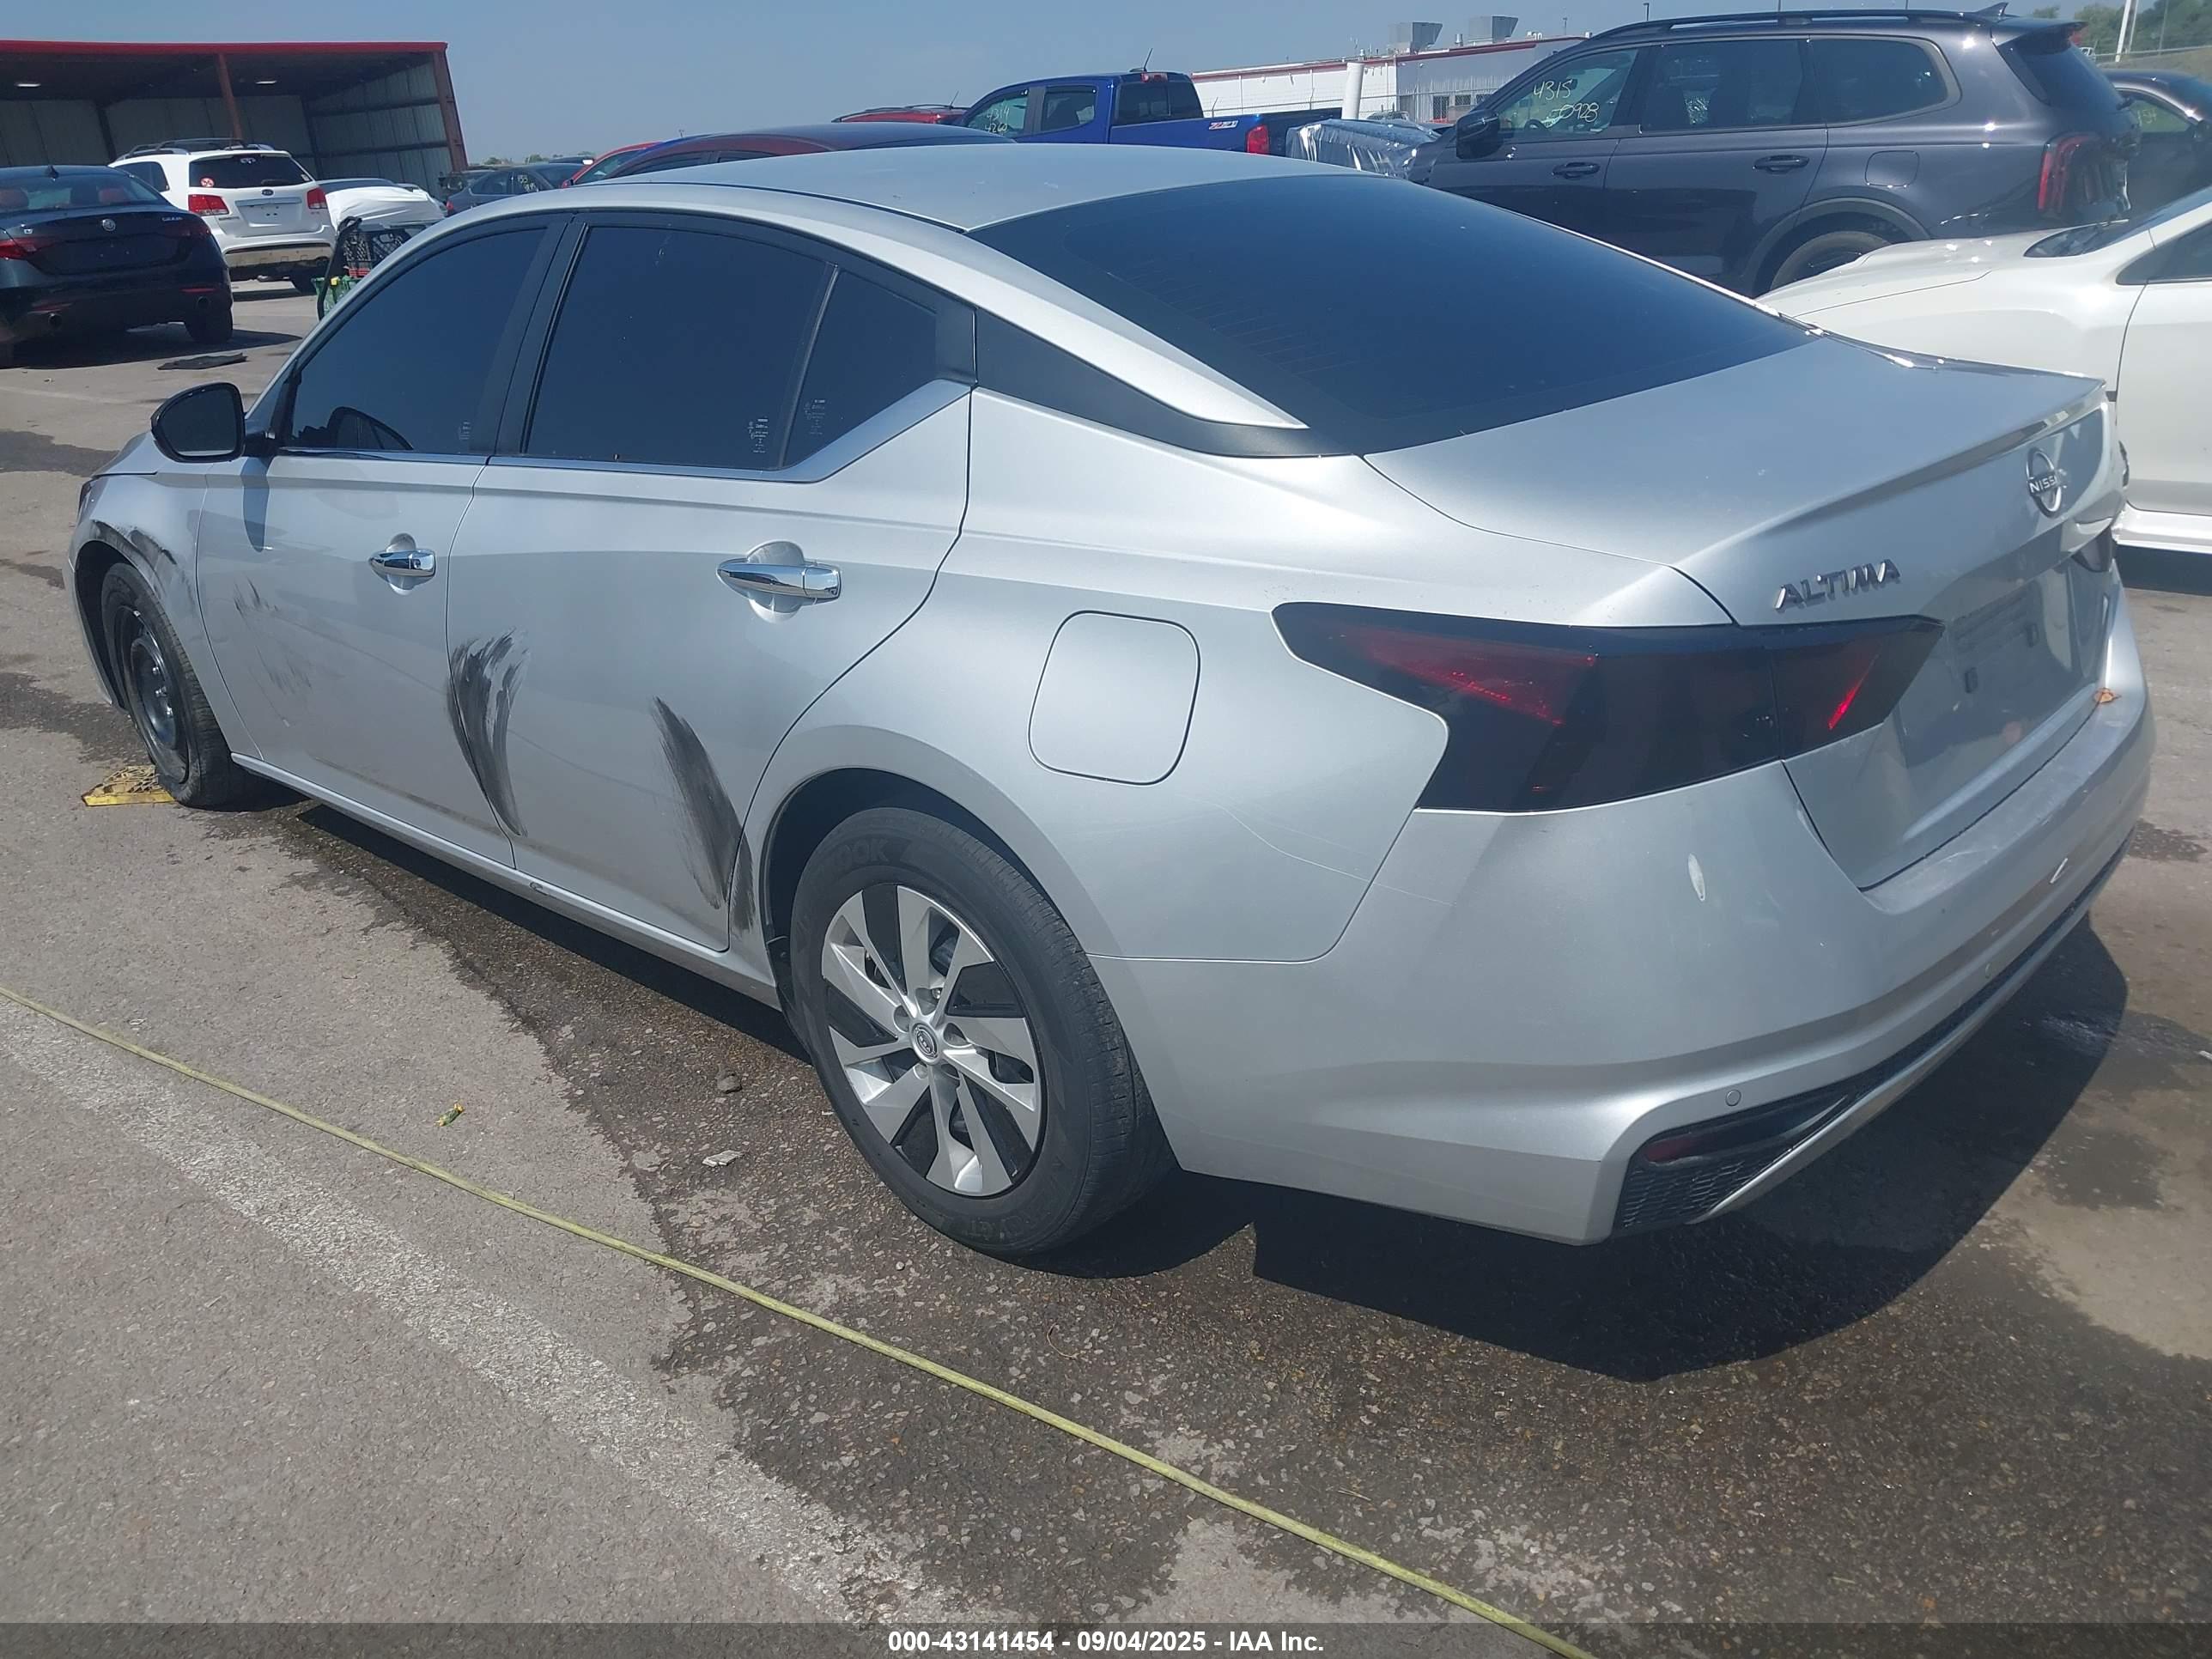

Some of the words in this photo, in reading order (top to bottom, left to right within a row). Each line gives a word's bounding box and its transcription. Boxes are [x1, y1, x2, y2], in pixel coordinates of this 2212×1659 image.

[1533, 79, 1572, 100] 4315
[986, 106, 1010, 122] 4314
[984, 123, 1008, 133] 4260
[2029, 475, 2058, 493] NISS
[1774, 559, 1900, 609] ALTIMA
